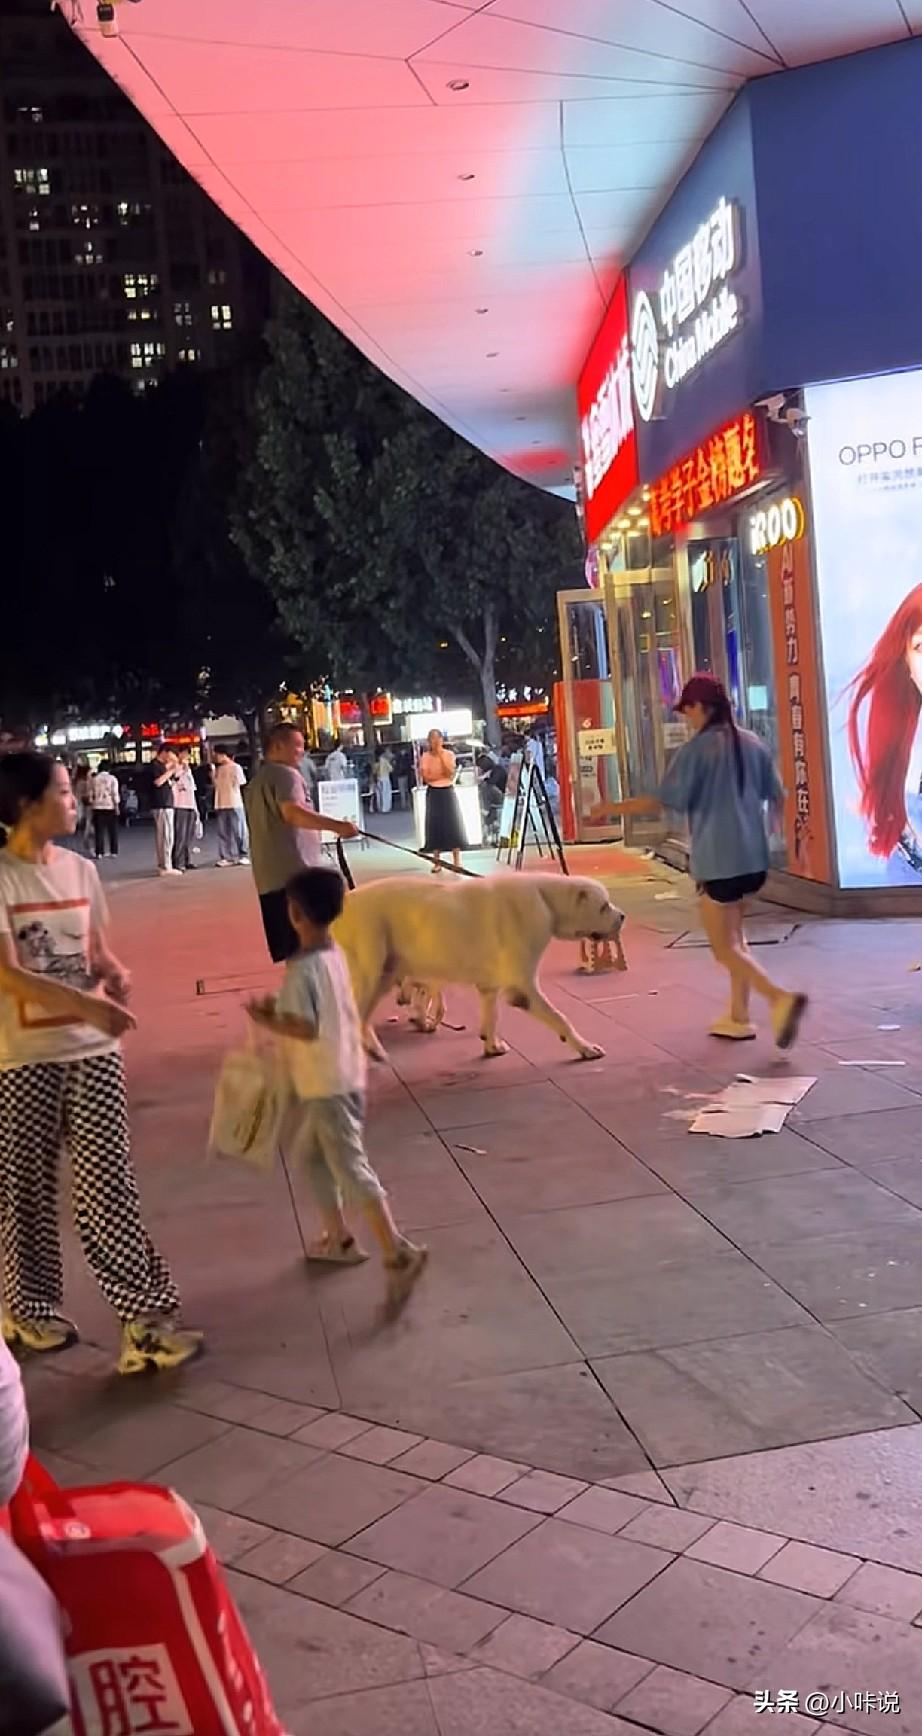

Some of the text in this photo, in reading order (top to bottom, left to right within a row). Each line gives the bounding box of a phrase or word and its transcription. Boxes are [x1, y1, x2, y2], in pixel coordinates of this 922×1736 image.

[660, 196, 735, 337] 中国移动
[664, 337, 697, 389] China
[839, 439, 906, 466] OPPO
[89, 1656, 181, 1736] 腔
